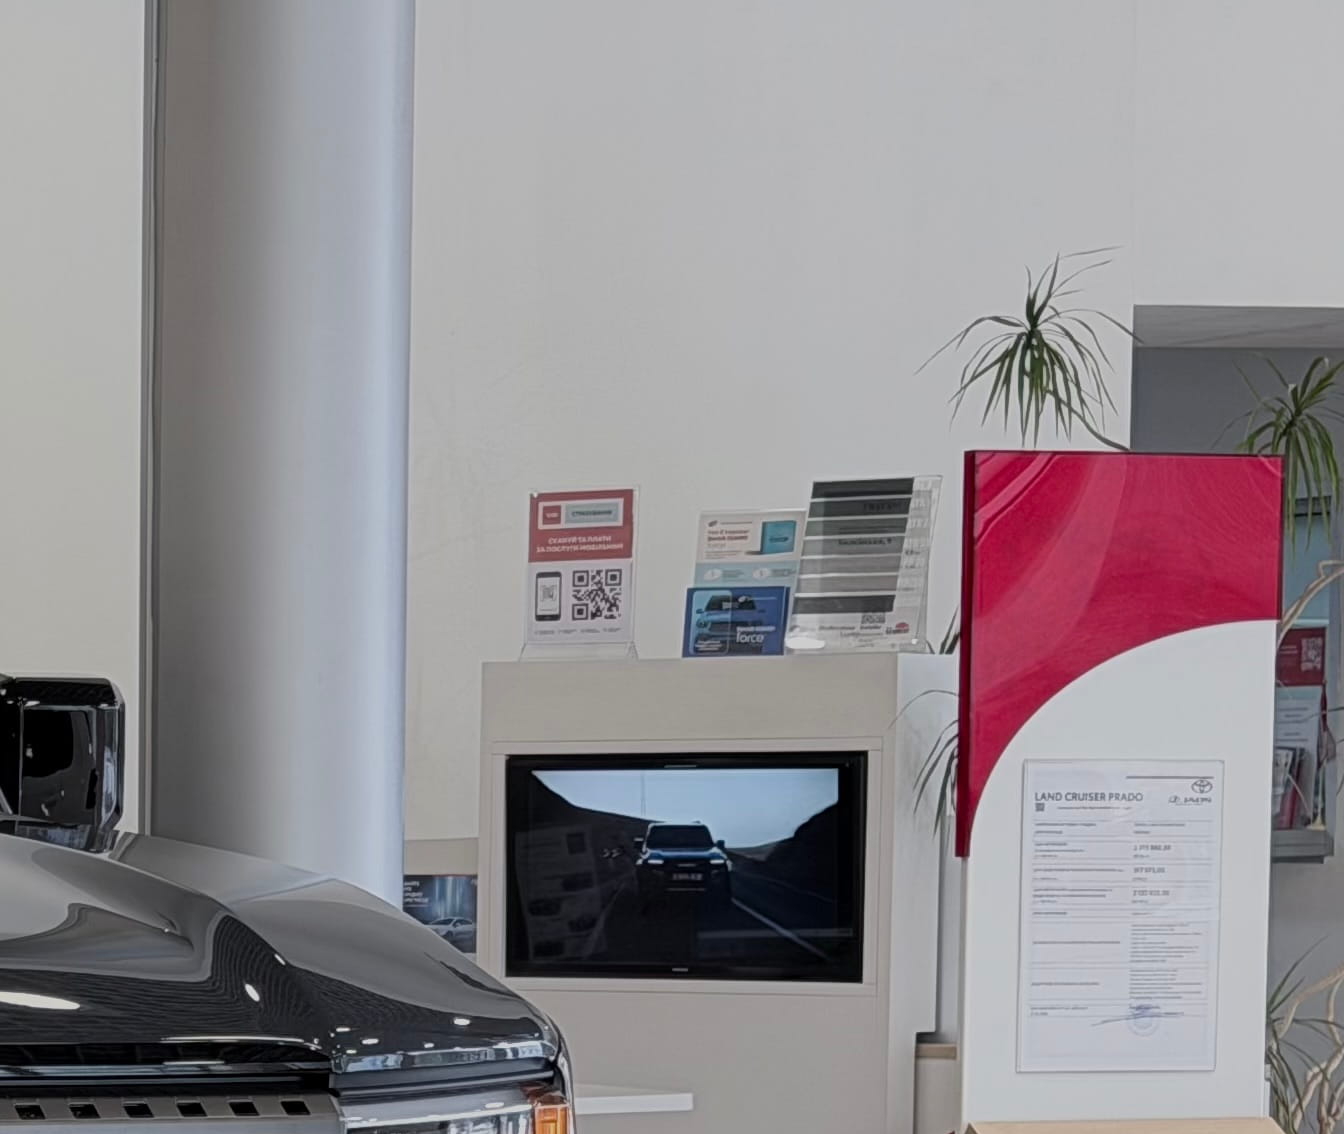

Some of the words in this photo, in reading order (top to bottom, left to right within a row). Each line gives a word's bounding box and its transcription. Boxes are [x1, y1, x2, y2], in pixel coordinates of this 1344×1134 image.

[1035, 792, 1063, 801] LAND
[1064, 792, 1106, 801] CRUISER
[1109, 792, 1144, 801] PRADO
